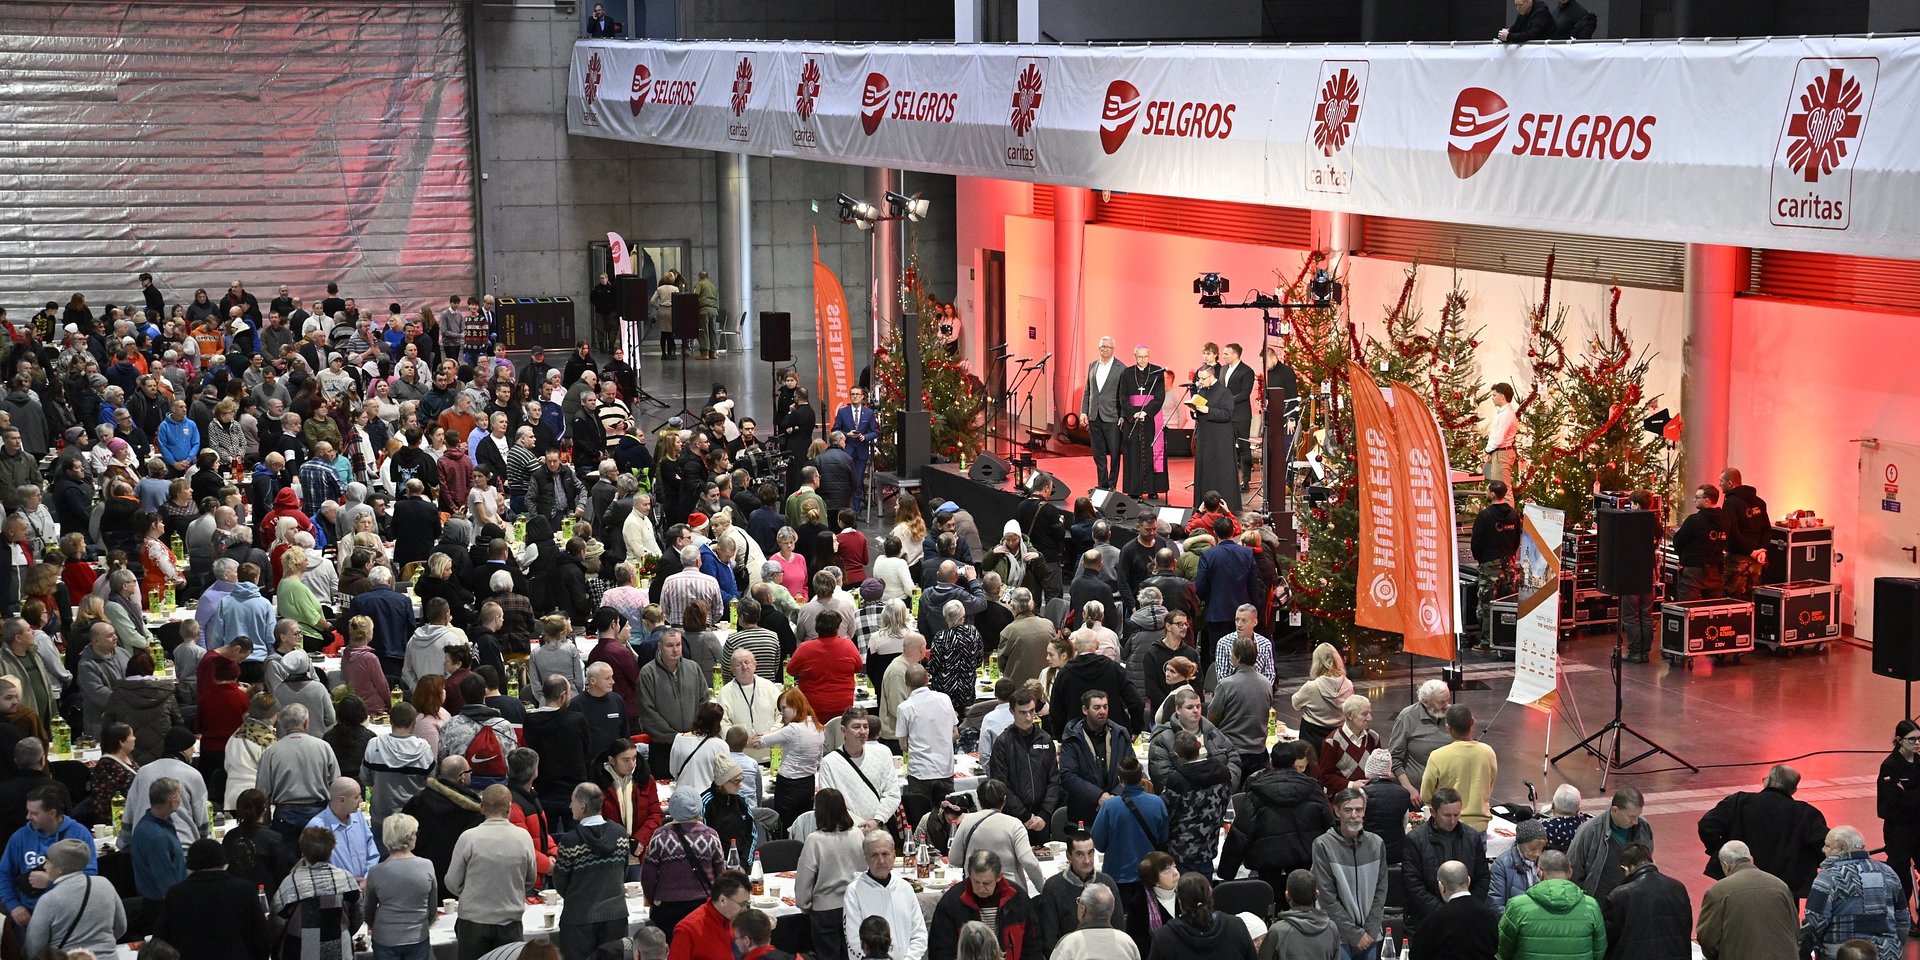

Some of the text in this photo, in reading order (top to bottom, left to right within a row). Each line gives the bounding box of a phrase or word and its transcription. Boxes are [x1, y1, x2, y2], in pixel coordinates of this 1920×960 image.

[651, 80, 697, 106] SELGROS
[891, 90, 958, 123] SELGROS
[1142, 100, 1236, 139] SELGROS
[729, 122, 748, 137] caritas
[794, 126, 815, 142] caritas
[1511, 112, 1657, 161] SELGROS
[1007, 143, 1034, 161] caritas
[1309, 164, 1347, 186] caritas
[1777, 192, 1843, 220] caritas
